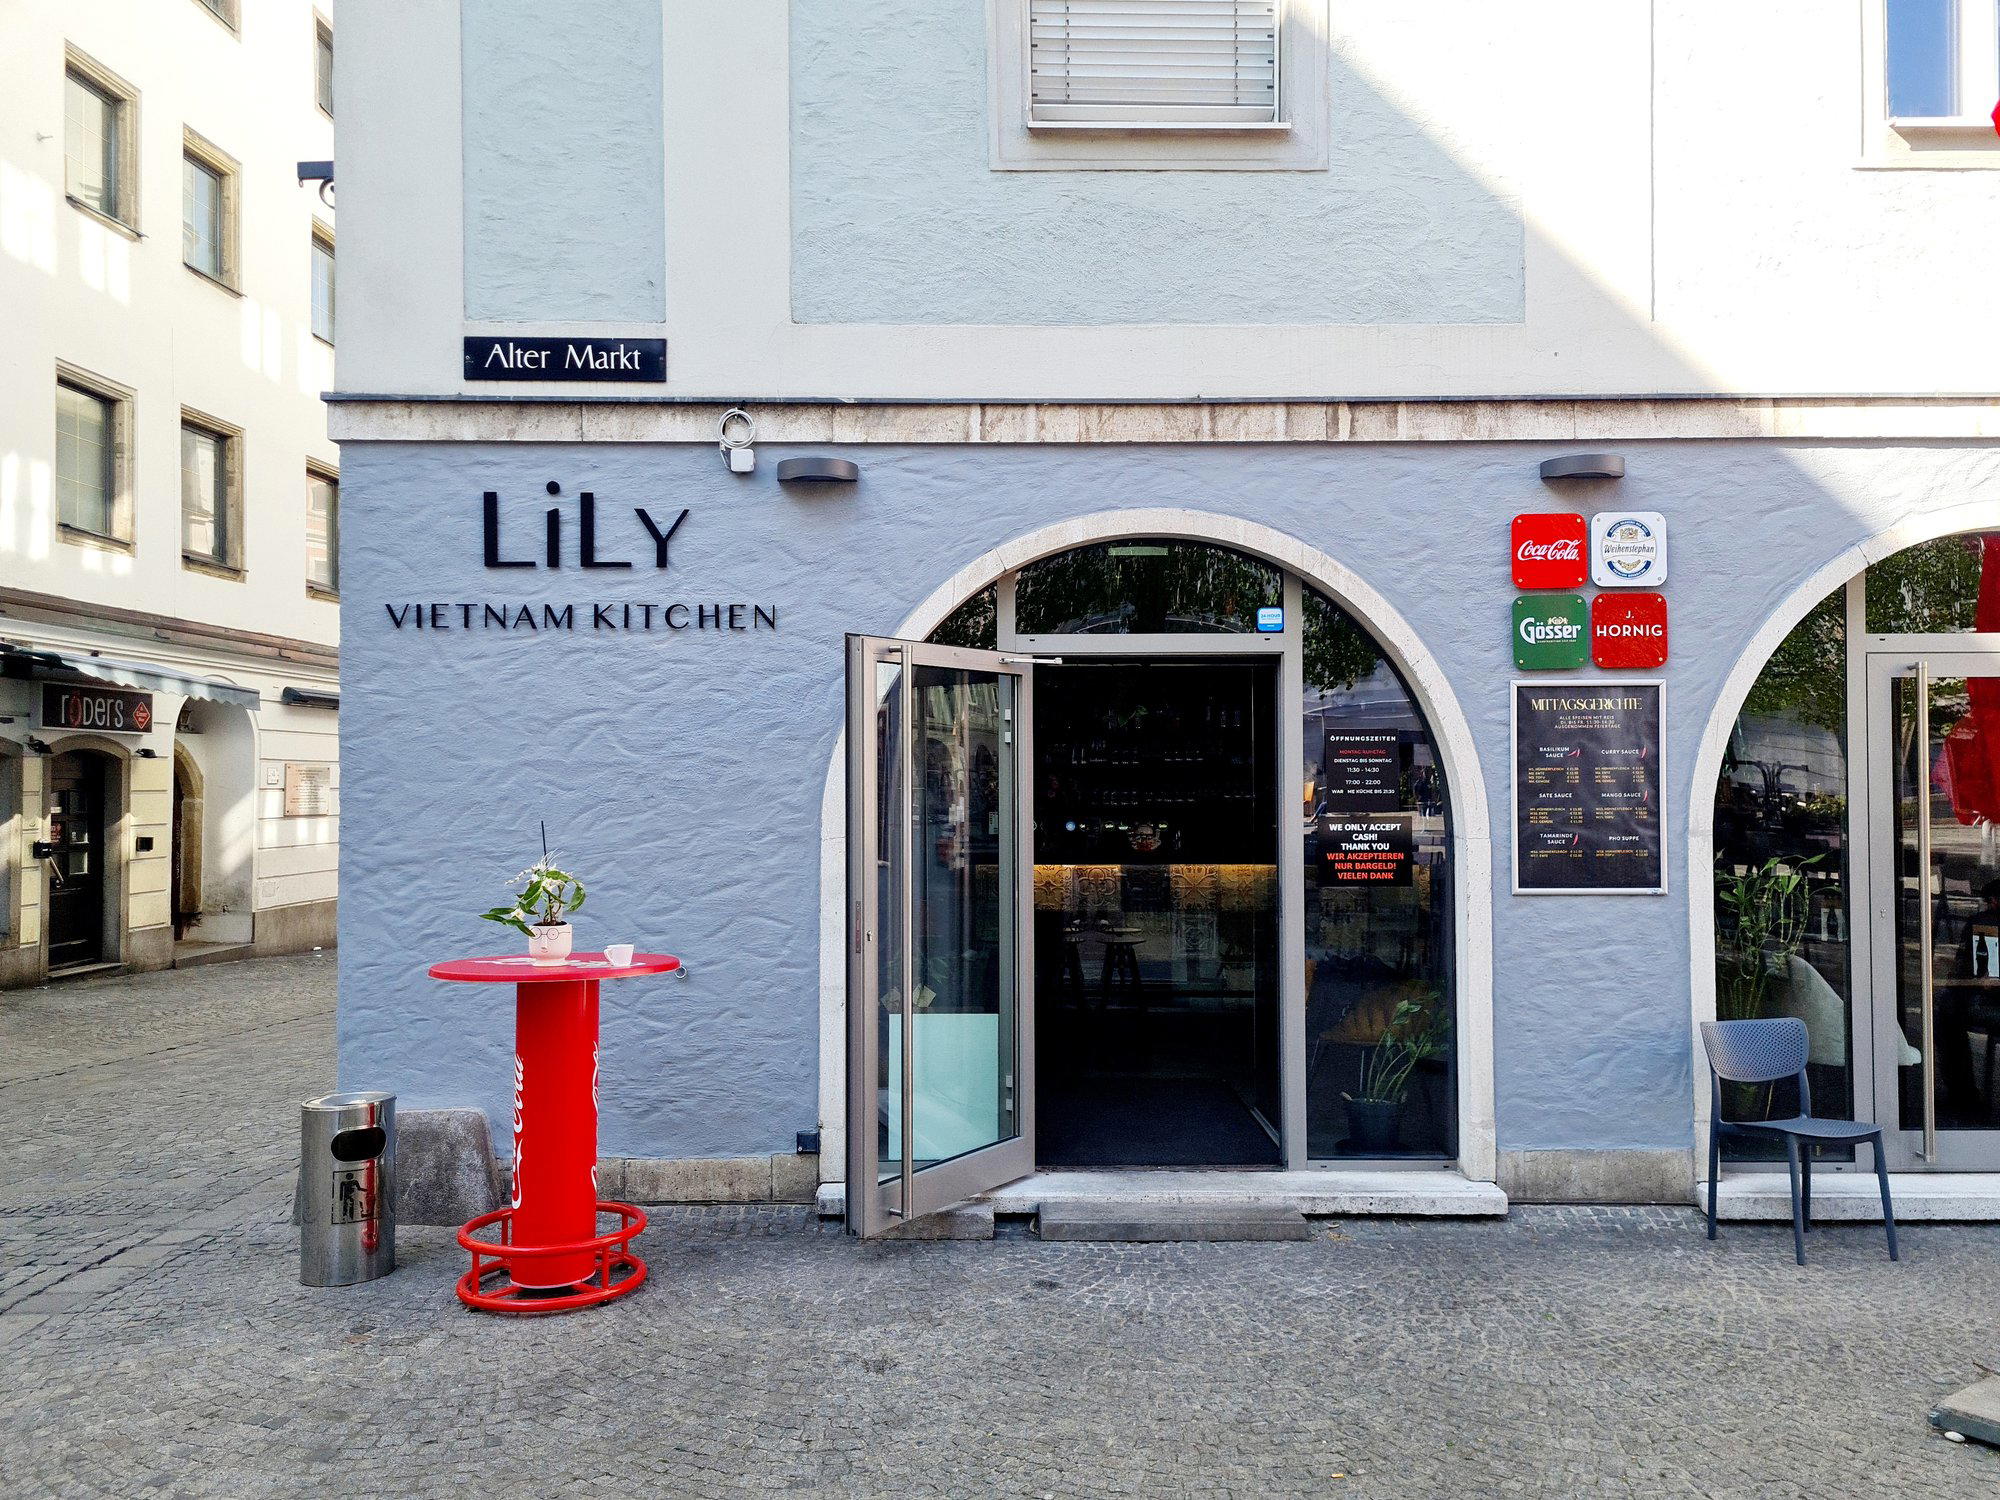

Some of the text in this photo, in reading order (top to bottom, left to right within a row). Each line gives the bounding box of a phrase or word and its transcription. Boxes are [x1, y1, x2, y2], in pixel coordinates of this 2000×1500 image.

[485, 343, 641, 370] Alter Markt
[483, 480, 690, 568] LiLY
[1518, 539, 1582, 561] Coca-Cola
[1604, 544, 1654, 554] Weihenstephan
[385, 603, 776, 630] VIETNAM KITCHEN
[1625, 610, 1635, 619] J.
[1520, 617, 1582, 645] Gösser
[1596, 624, 1663, 637] HORNIG
[1531, 698, 1642, 711] MITTAGSGERICHTE
[1372, 842, 1390, 850] YOU
